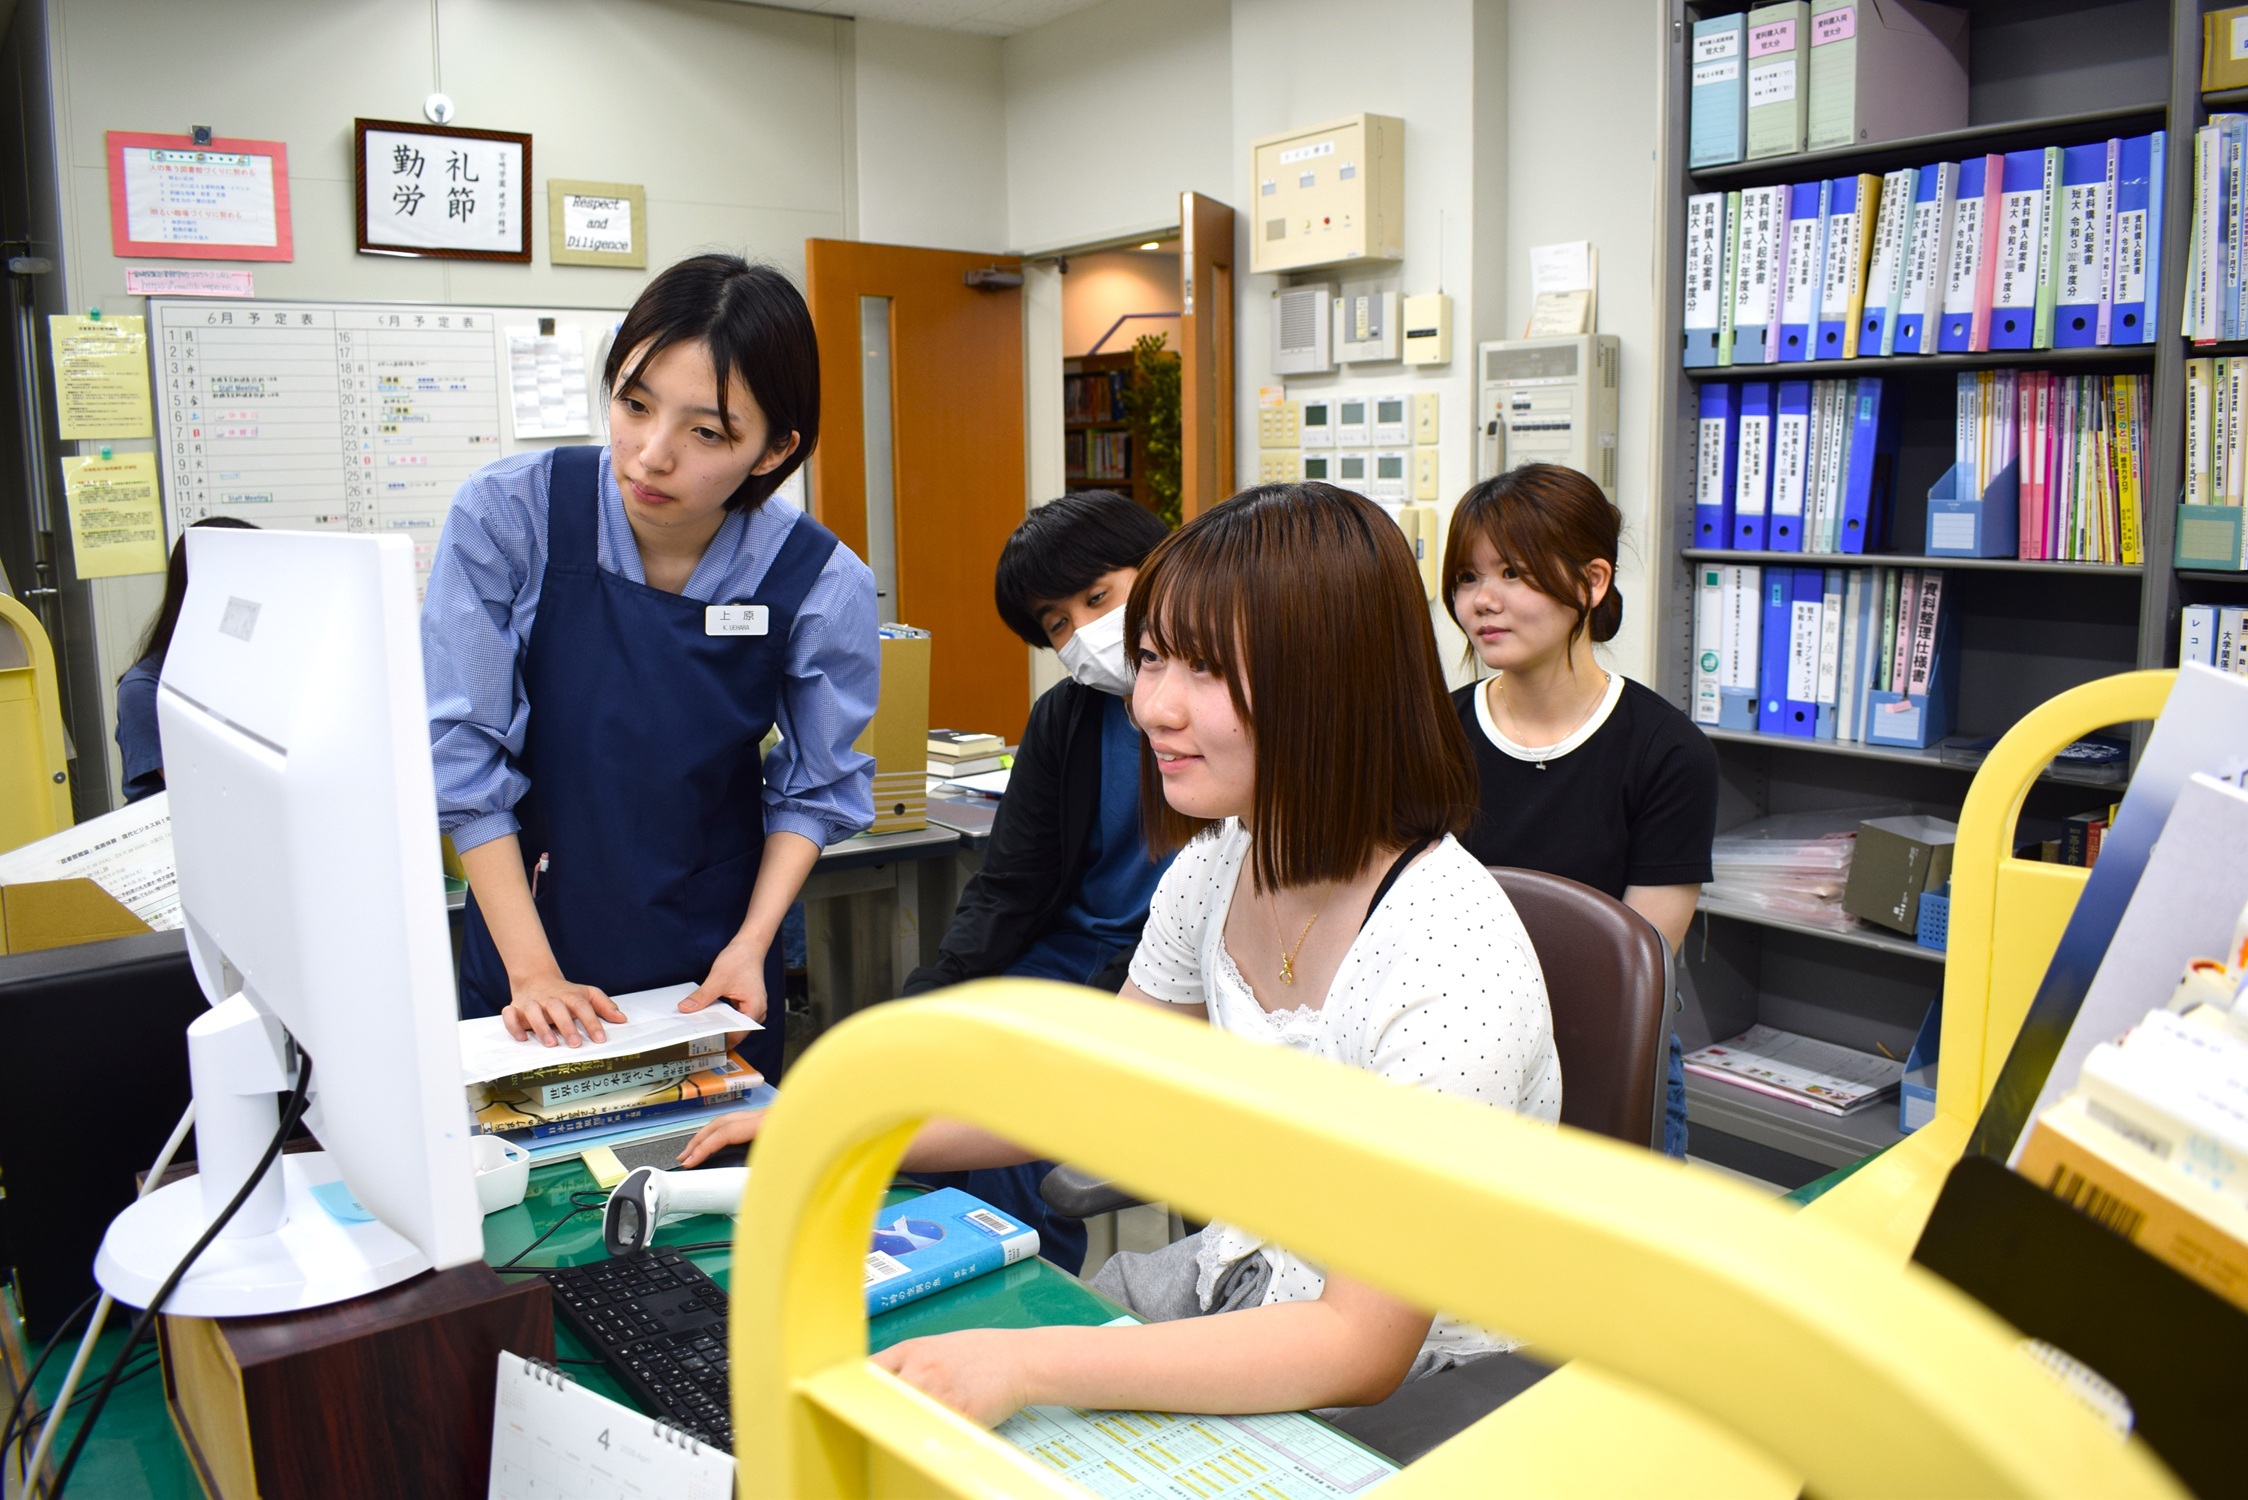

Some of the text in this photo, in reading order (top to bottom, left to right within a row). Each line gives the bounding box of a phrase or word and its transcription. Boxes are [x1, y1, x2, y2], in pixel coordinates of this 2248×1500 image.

[392, 144, 426, 217] 勤労
[445, 150, 480, 223] 礼節
[1882, 178, 1891, 198] 短大
[572, 195, 620, 210] Respect
[2071, 188, 2082, 210] 短大
[1744, 194, 1754, 220] 短大
[1885, 176, 1900, 248] 資料購入起案書
[2009, 197, 2020, 218] 短大
[1690, 204, 1700, 228] 短大
[1913, 209, 1922, 230] 短大
[586, 218, 608, 230] and
[1831, 218, 1840, 236] 短大
[2083, 186, 2096, 266] 資料購入起案書
[2121, 216, 2130, 234] 短大
[1756, 193, 1770, 285] 資料購入起案書
[1792, 226, 1800, 242] 短大
[1963, 201, 1976, 276] 資料購入起案書
[2017, 196, 2032, 273] 資料購入起案書
[567, 236, 629, 251] Diligence
[1702, 202, 1714, 292] 資料購入起案書
[1838, 217, 1850, 284] 資料購入起案書
[1916, 208, 1930, 282] 資料購入起案書
[1952, 202, 1968, 292] 短大 令和元年度分
[2133, 214, 2142, 275] 資料購入起案書
[1800, 224, 1812, 286] 資料購入起案書
[170, 330, 175, 341] 1
[338, 332, 350, 343] 16
[170, 346, 176, 358] 2
[340, 348, 350, 358] 17
[172, 362, 178, 374] 3
[340, 364, 352, 374] 18
[172, 379, 179, 390] 4
[341, 379, 353, 390] 19
[174, 395, 181, 406] 5
[342, 394, 354, 405] 20
[175, 411, 182, 422] 6
[343, 410, 355, 420] 21
[176, 427, 183, 438] 7
[344, 425, 356, 436] 22
[177, 443, 184, 454] 8
[344, 440, 358, 451] 23
[178, 459, 186, 470] 9
[346, 455, 358, 466] 24
[177, 474, 190, 486] 10
[346, 470, 360, 482] 25
[178, 491, 190, 502] 11
[348, 486, 360, 497] 26
[180, 508, 192, 518] 12
[349, 501, 361, 512] 27
[350, 516, 363, 528] 28
[720, 610, 754, 621] 上原
[1912, 582, 1939, 684] 資料整理仕様書
[1803, 630, 1814, 699] オープンキャンパス
[550, 1066, 654, 1100] 世界の果ての本屋さん
[598, 1428, 610, 1451] 4
